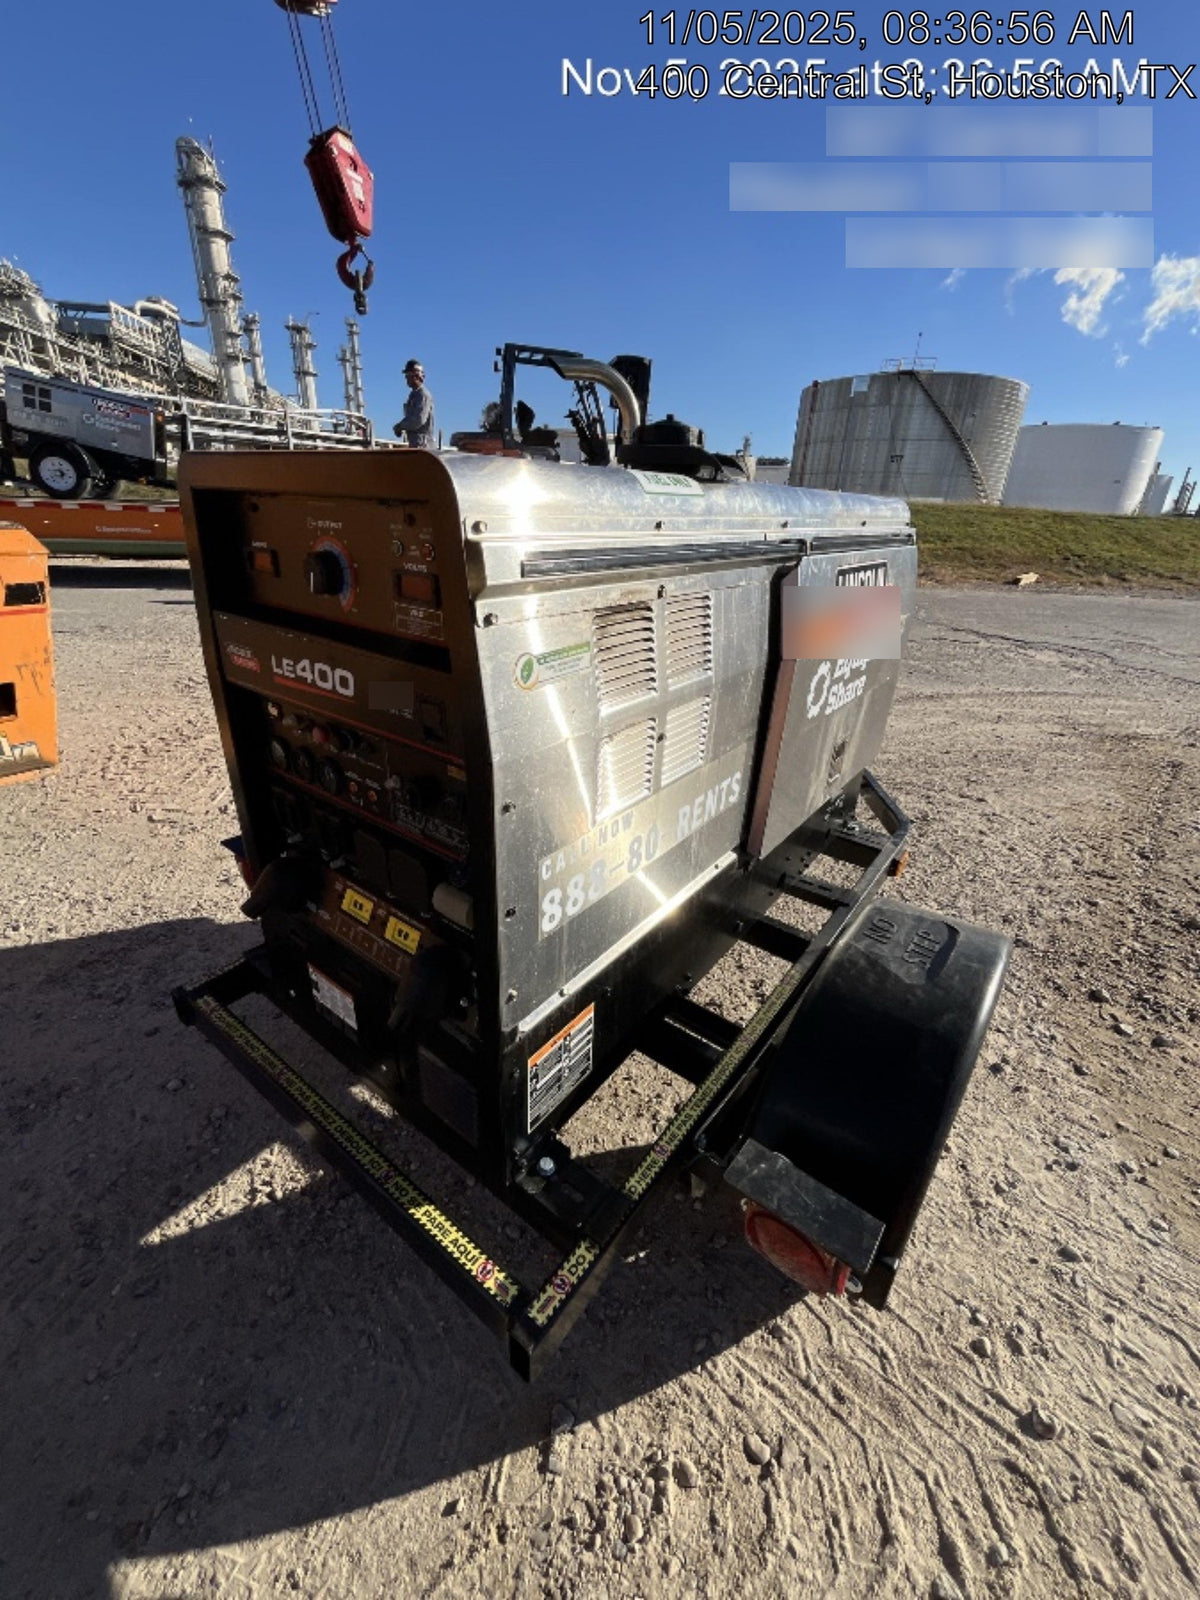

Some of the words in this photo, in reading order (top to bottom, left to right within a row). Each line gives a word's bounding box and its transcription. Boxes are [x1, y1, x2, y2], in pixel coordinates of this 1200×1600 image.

[271, 653, 355, 697] LE400
[824, 674, 867, 715] Share
[676, 770, 741, 841] RENTS
[597, 810, 634, 848] NOW
[863, 918, 896, 945] NO
[902, 929, 941, 969] STEP
[389, 1178, 410, 1198] NO
[420, 1207, 453, 1240] PARE
[565, 1253, 588, 1277] DO
